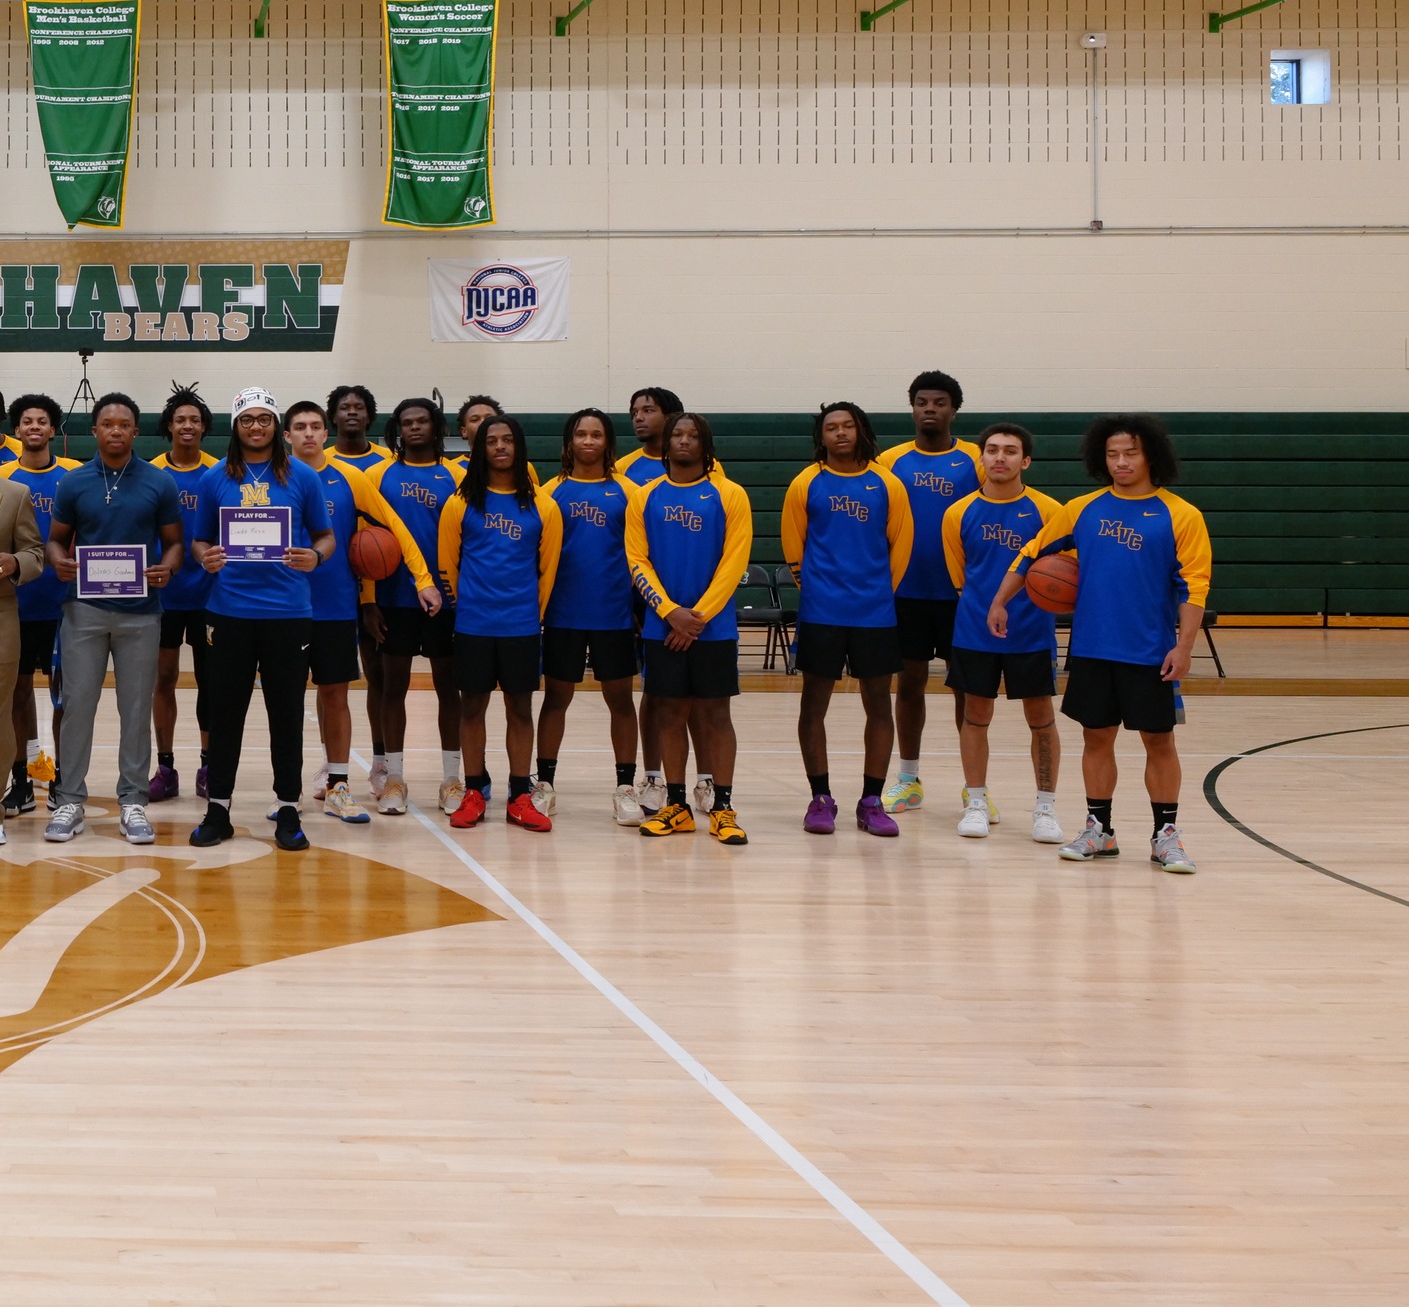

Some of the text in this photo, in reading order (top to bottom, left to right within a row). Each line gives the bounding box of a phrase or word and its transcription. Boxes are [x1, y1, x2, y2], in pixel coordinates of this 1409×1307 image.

[29, 6, 93, 14] Brookhaven
[0, 264, 322, 330] HAVEN
[466, 287, 536, 320] NJCAA
[102, 311, 250, 342] BEARS
[240, 482, 270, 508] M
[401, 483, 437, 508] MVC
[914, 472, 953, 496] MVC
[570, 501, 606, 526] MVC
[664, 506, 702, 531] MVC
[829, 496, 868, 522] MVC
[485, 513, 521, 540] MVC
[982, 524, 1021, 550] MVC
[1099, 520, 1143, 550] MVC
[632, 565, 662, 611] LIONS
